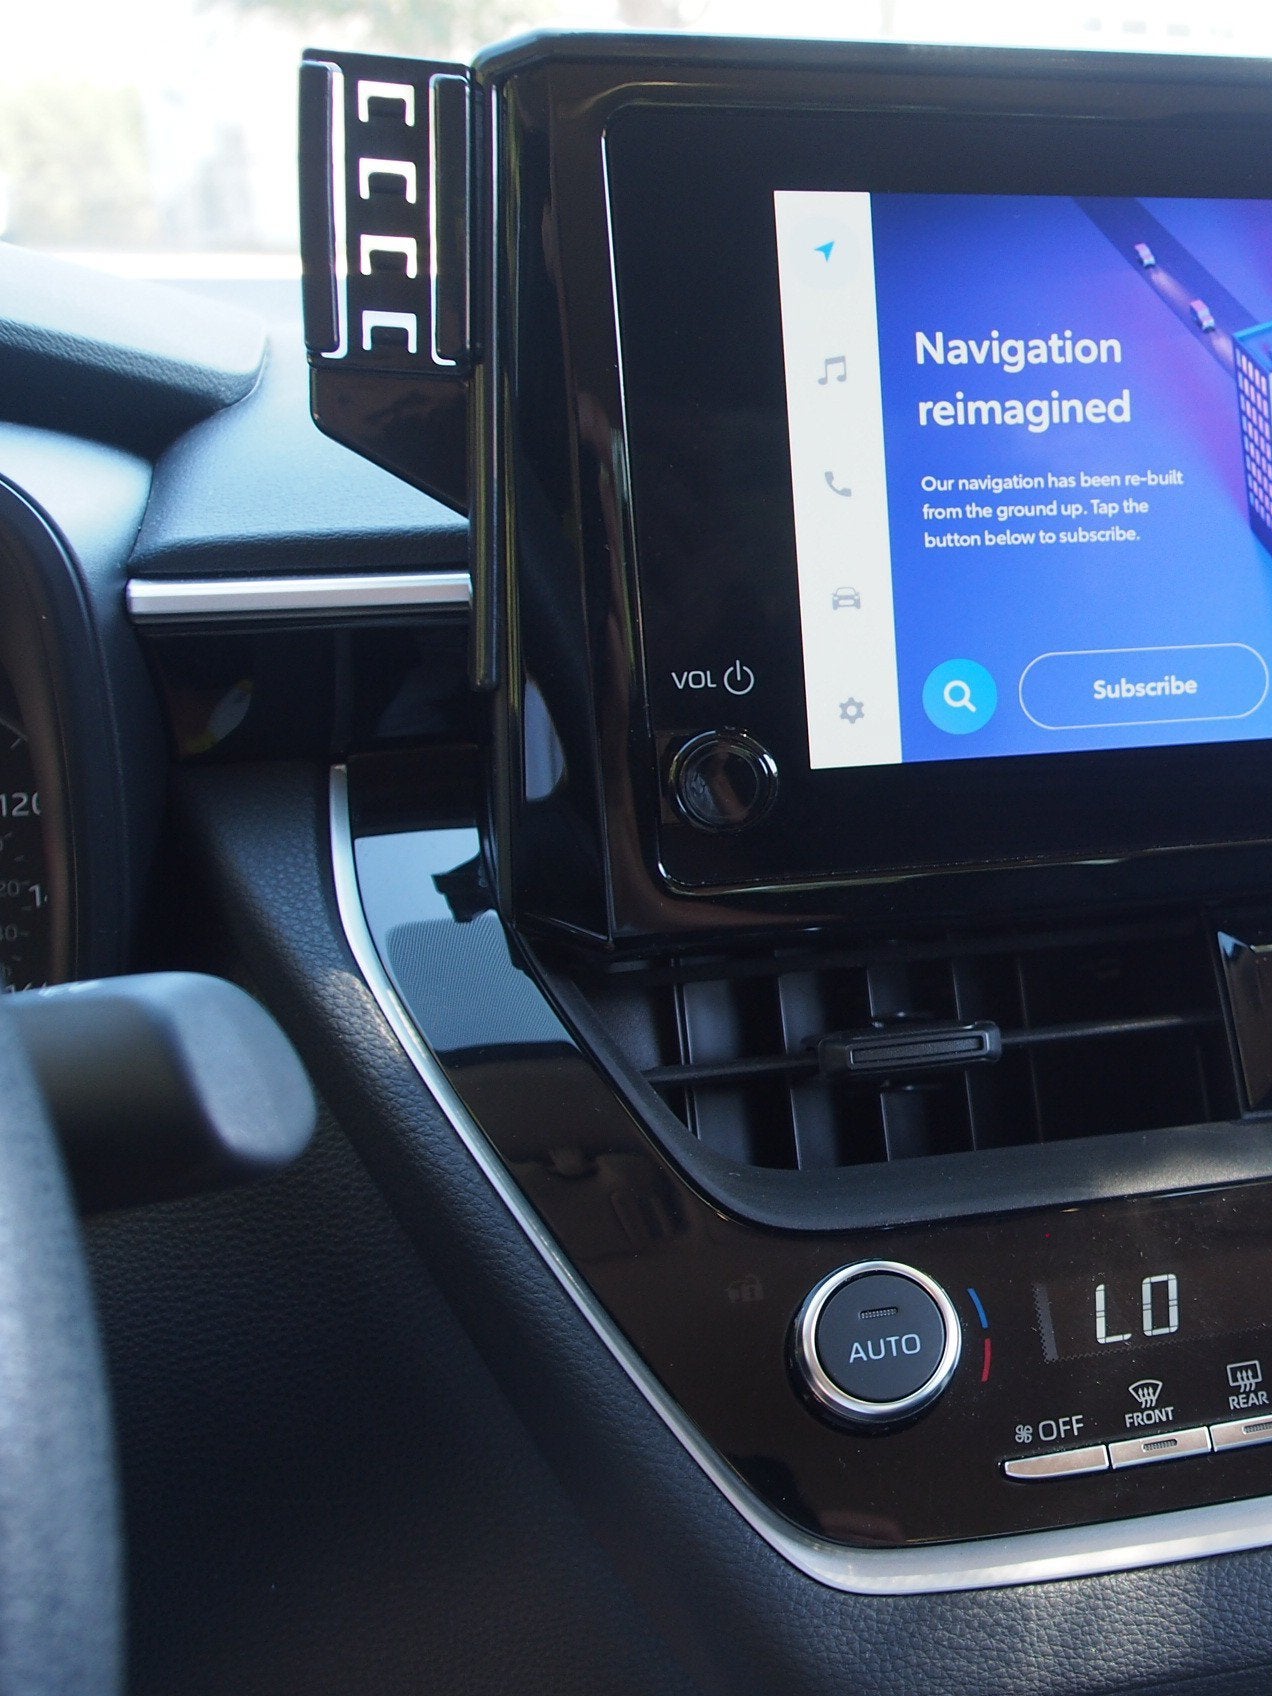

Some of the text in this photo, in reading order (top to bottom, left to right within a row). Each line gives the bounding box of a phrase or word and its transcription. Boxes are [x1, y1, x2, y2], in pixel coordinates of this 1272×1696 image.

[915, 329, 1122, 374] Navigation
[918, 388, 1132, 434] reimagined
[921, 469, 1184, 494] Our navigation has been re-built
[922, 497, 1149, 522] from the ground up. Tap the
[924, 525, 1141, 549] button below to subscribe.
[671, 670, 717, 690] VOL
[1092, 674, 1199, 700] Subscribe
[1095, 1273, 1179, 1345] LO
[849, 1333, 922, 1364] AUTO
[1228, 1390, 1270, 1411] REAR
[1038, 1414, 1085, 1442] OFF
[1124, 1406, 1175, 1429] FRONT
